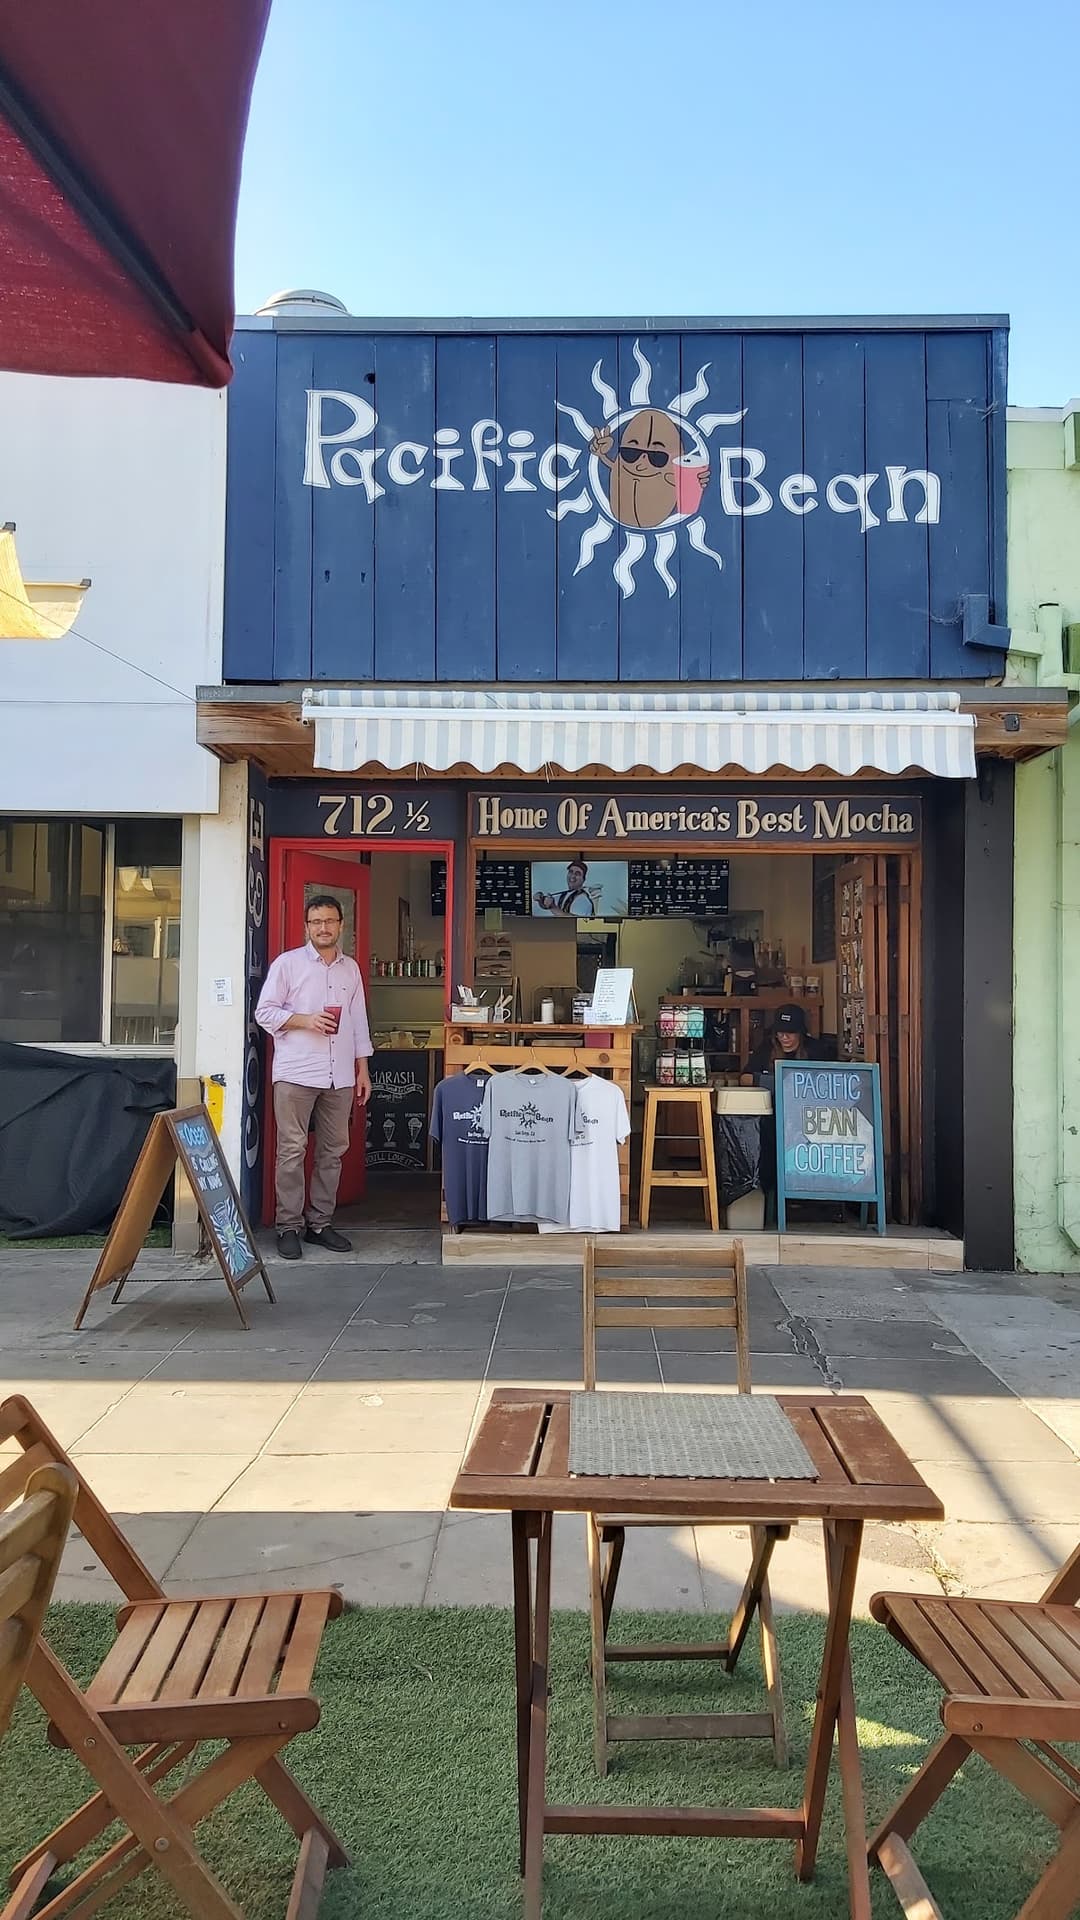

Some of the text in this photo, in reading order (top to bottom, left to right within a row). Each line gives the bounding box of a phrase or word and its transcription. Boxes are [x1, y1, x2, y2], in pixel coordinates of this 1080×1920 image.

[303, 389, 942, 533] Pacific Bean
[317, 794, 396, 835] 712
[478, 797, 914, 839] Home Of America's Best Mocha
[794, 1072, 861, 1100] PACIFIC
[803, 1105, 858, 1136] BEAN
[795, 1143, 866, 1174] COFFEE
